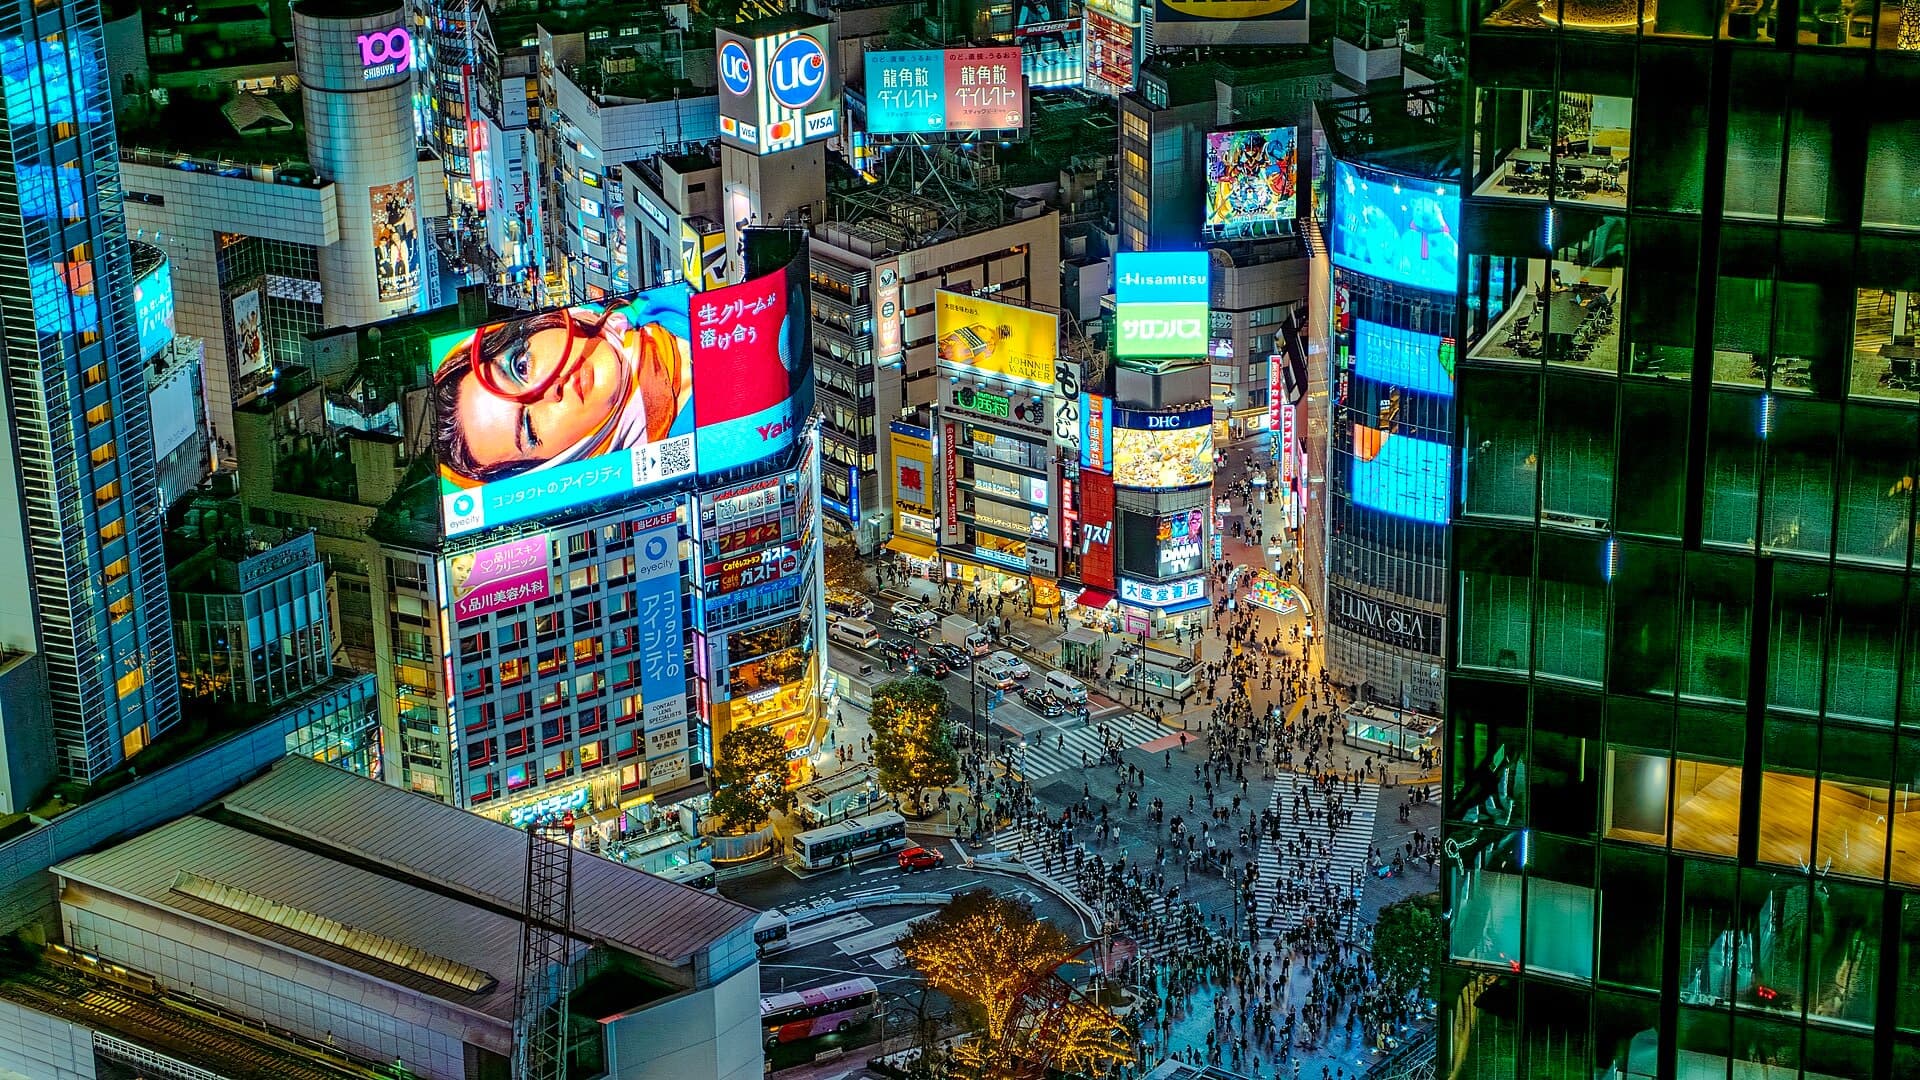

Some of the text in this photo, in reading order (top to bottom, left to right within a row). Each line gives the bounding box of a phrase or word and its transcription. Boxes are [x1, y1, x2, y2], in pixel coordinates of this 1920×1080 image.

[1027, 23, 1069, 33] SKECHERS
[357, 27, 410, 72] 109
[363, 64, 395, 79] SHIBUYA
[882, 67, 929, 88] 龍角散
[960, 65, 1007, 85] 龍角散
[877, 89, 938, 109] ダイレクト
[955, 87, 1016, 106] ダイレクト
[741, 127, 755, 137] VISA
[808, 115, 833, 130] VISA
[1120, 272, 1206, 285] Hisamitsu
[697, 293, 776, 326] 生クリームが
[699, 323, 758, 350] 溶け合う
[1122, 319, 1202, 339] サロンパス
[1008, 355, 1050, 373] JOHNNIE
[1008, 364, 1050, 380] WALKER
[977, 398, 1008, 417] 西村
[1055, 362, 1080, 448] もんじゃ
[757, 413, 795, 441] Yak
[1148, 415, 1180, 428] DHC
[1090, 399, 1101, 466] 三千里薬品
[900, 465, 922, 491] 薬
[491, 466, 623, 510] コンタクトのアイシティ
[738, 493, 776, 512] しゃぶ葉
[449, 514, 480, 529] eyecity
[637, 513, 673, 531] 当ビル5F
[702, 509, 715, 521] 9F
[1082, 520, 1112, 555] クスリ
[493, 542, 542, 564] 品川スキン
[761, 545, 792, 564] ガスト
[1160, 543, 1200, 563] DMM
[495, 556, 537, 575] クリニック
[640, 558, 673, 575] eyecity
[1171, 557, 1190, 572] TV
[741, 564, 777, 587] ガスト
[705, 579, 720, 592] 7F
[1126, 581, 1199, 601] 大盛堂書店
[468, 579, 545, 613] 品川美容外科
[1340, 592, 1426, 640] LUNA SEA
[642, 593, 663, 681] アイシティ
[663, 590, 679, 677] コンタクトの
[652, 699, 677, 711] CONTACT
[658, 708, 672, 716] LENS
[649, 710, 682, 724] SPECIALISTS
[510, 787, 589, 827] サンドラッグ
